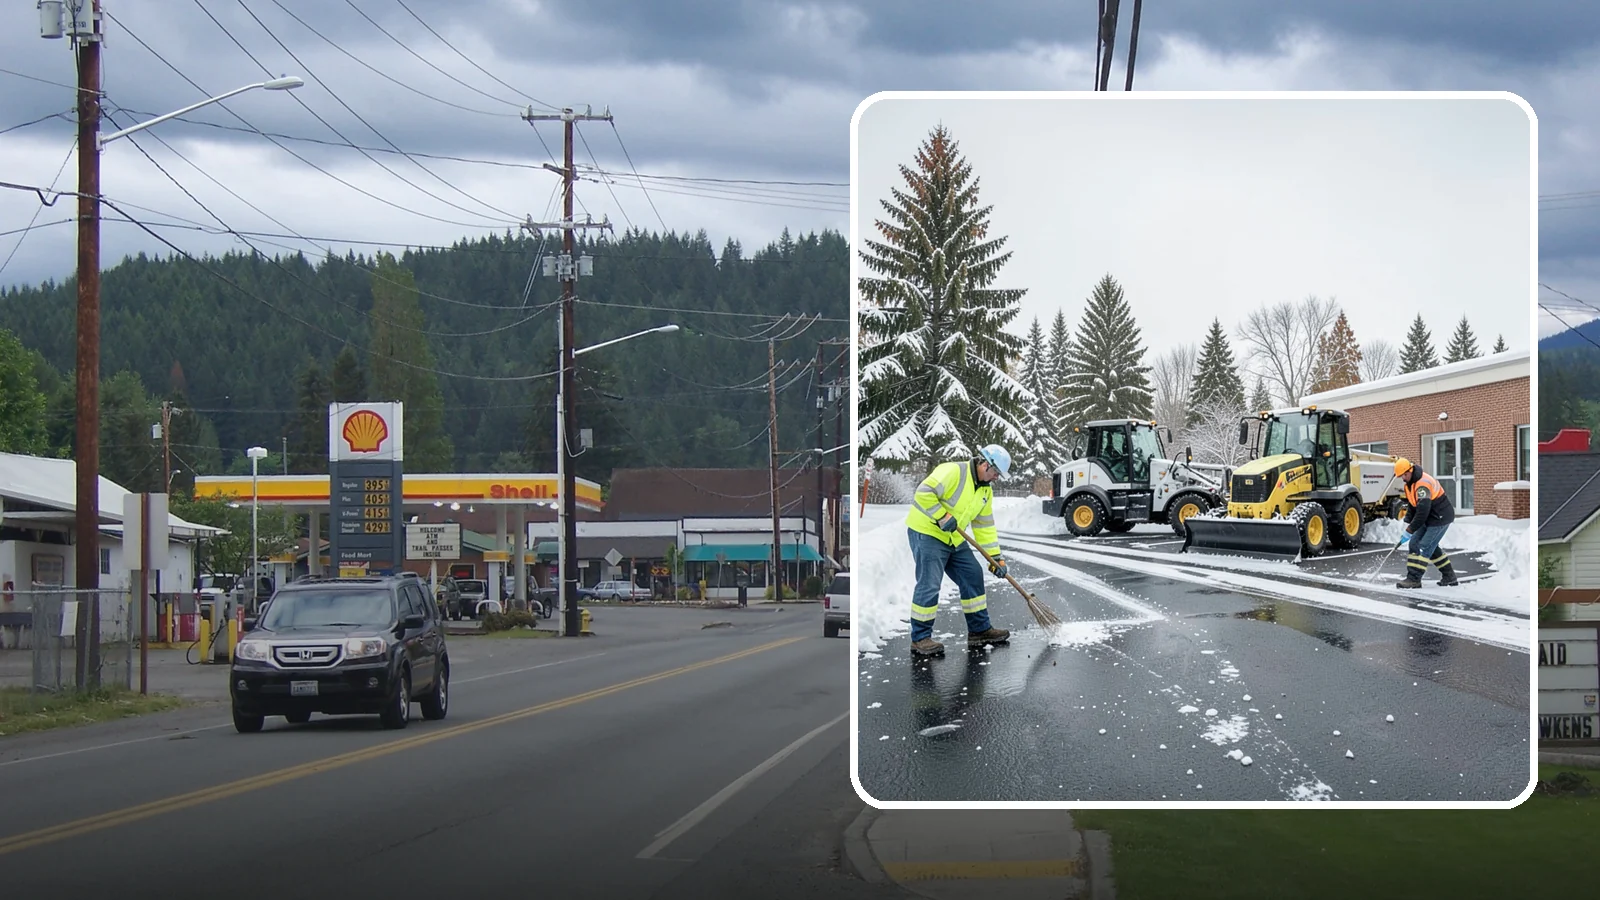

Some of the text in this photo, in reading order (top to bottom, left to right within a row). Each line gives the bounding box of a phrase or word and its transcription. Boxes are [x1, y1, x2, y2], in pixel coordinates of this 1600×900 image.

[366, 480, 383, 490] 395
[490, 484, 547, 498] Shell
[366, 494, 383, 504] 405
[366, 508, 383, 518] 415
[366, 522, 383, 532] 429
[1538, 643, 1567, 665] AID
